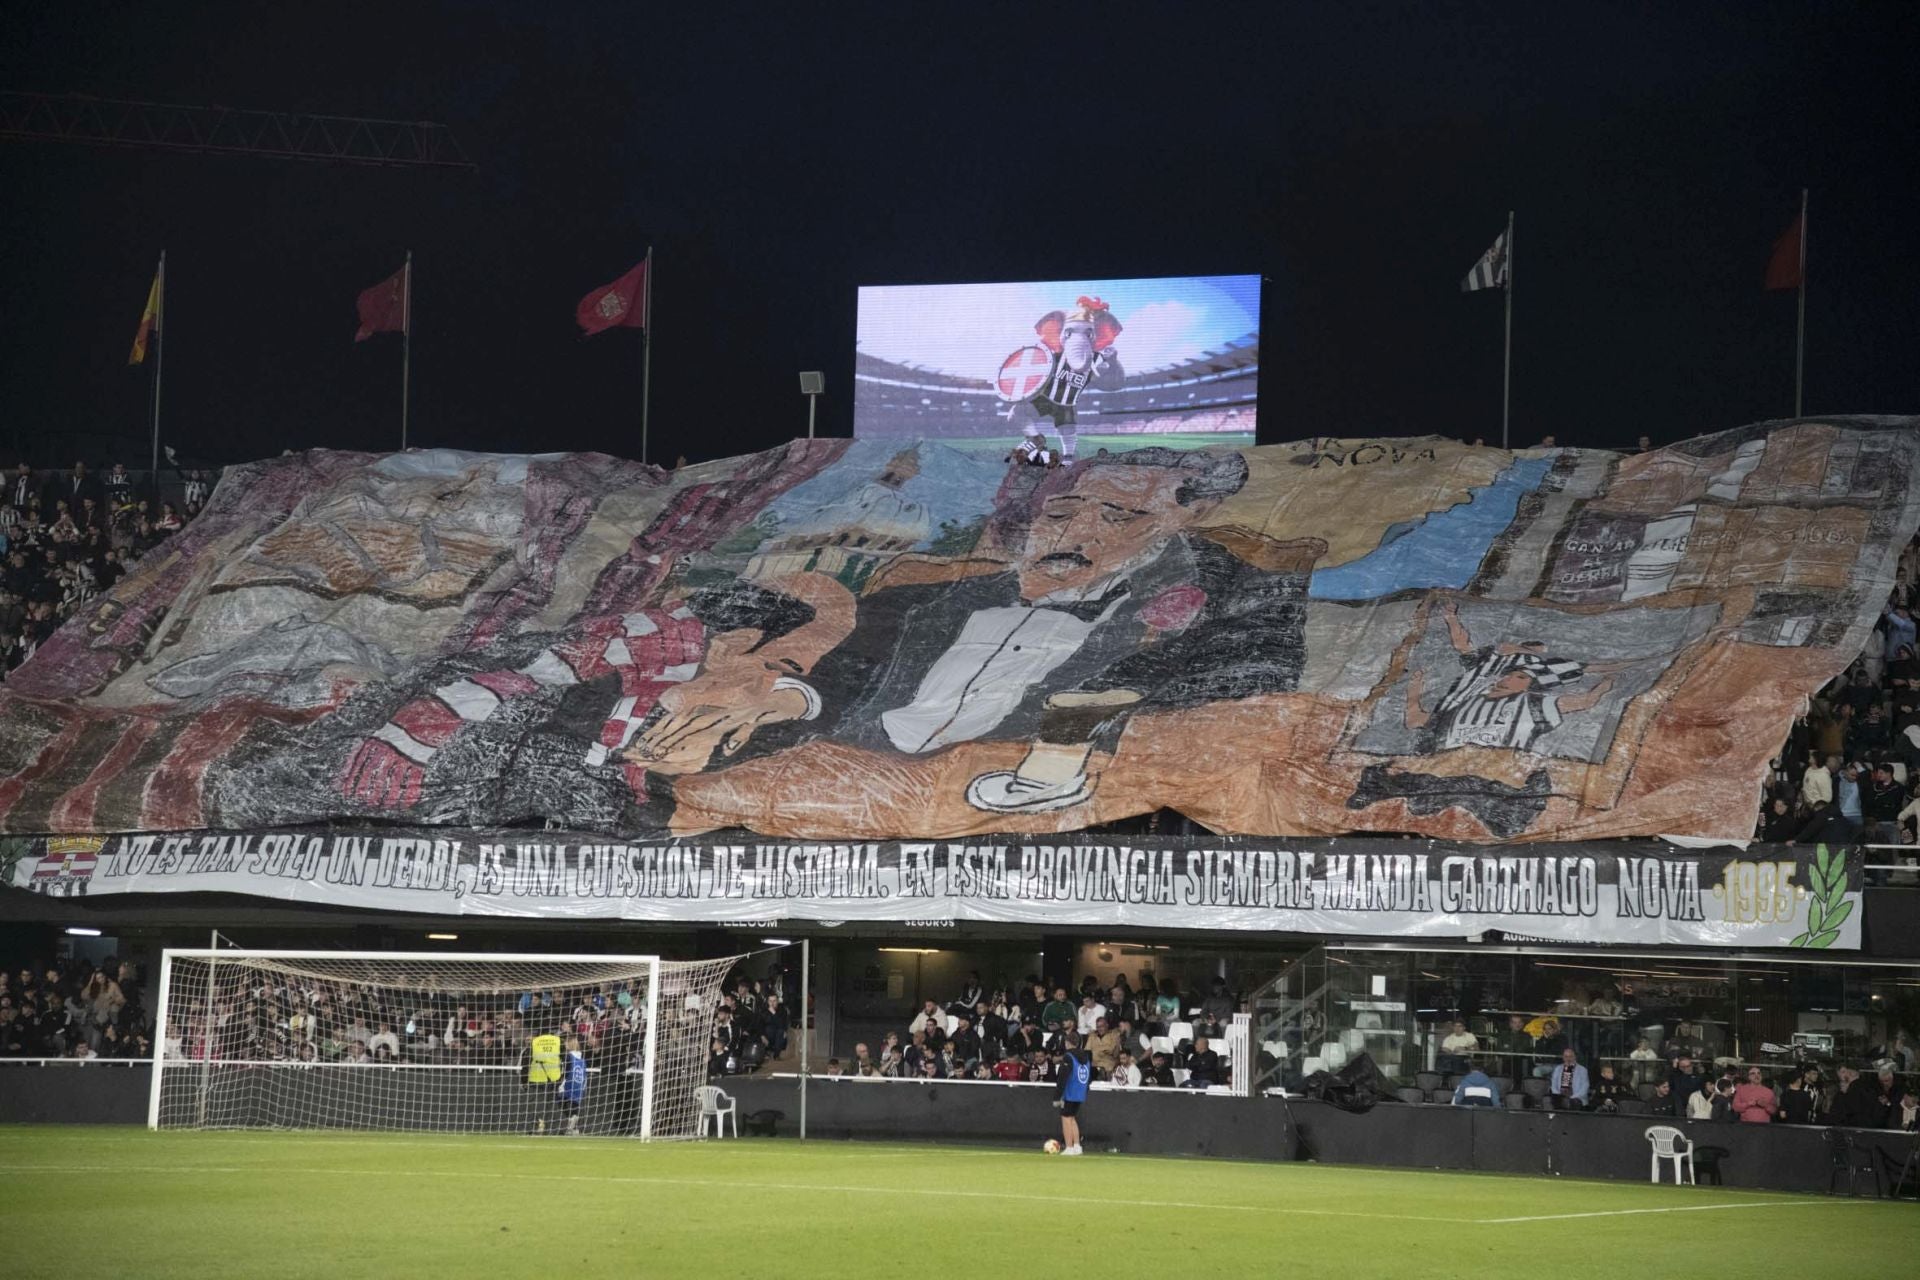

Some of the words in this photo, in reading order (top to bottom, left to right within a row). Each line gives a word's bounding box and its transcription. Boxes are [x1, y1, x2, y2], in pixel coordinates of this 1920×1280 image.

[105, 835, 157, 877] NO
[147, 835, 192, 875] ES
[187, 835, 252, 873] TAN
[248, 834, 324, 881] SOLO
[326, 836, 372, 886] UN
[472, 843, 506, 896] ES
[512, 844, 568, 897] UNA
[708, 844, 744, 898] DE
[752, 844, 889, 899] HISTORIA.
[897, 843, 936, 898] EN
[945, 844, 1009, 899] ESTA
[1017, 846, 1177, 905] PROVINCIA
[1185, 850, 1315, 910] SIEMPRE
[1321, 854, 1434, 912] MANDA
[1440, 856, 1598, 916] CARTHAGO
[1616, 857, 1706, 921] NOVA
